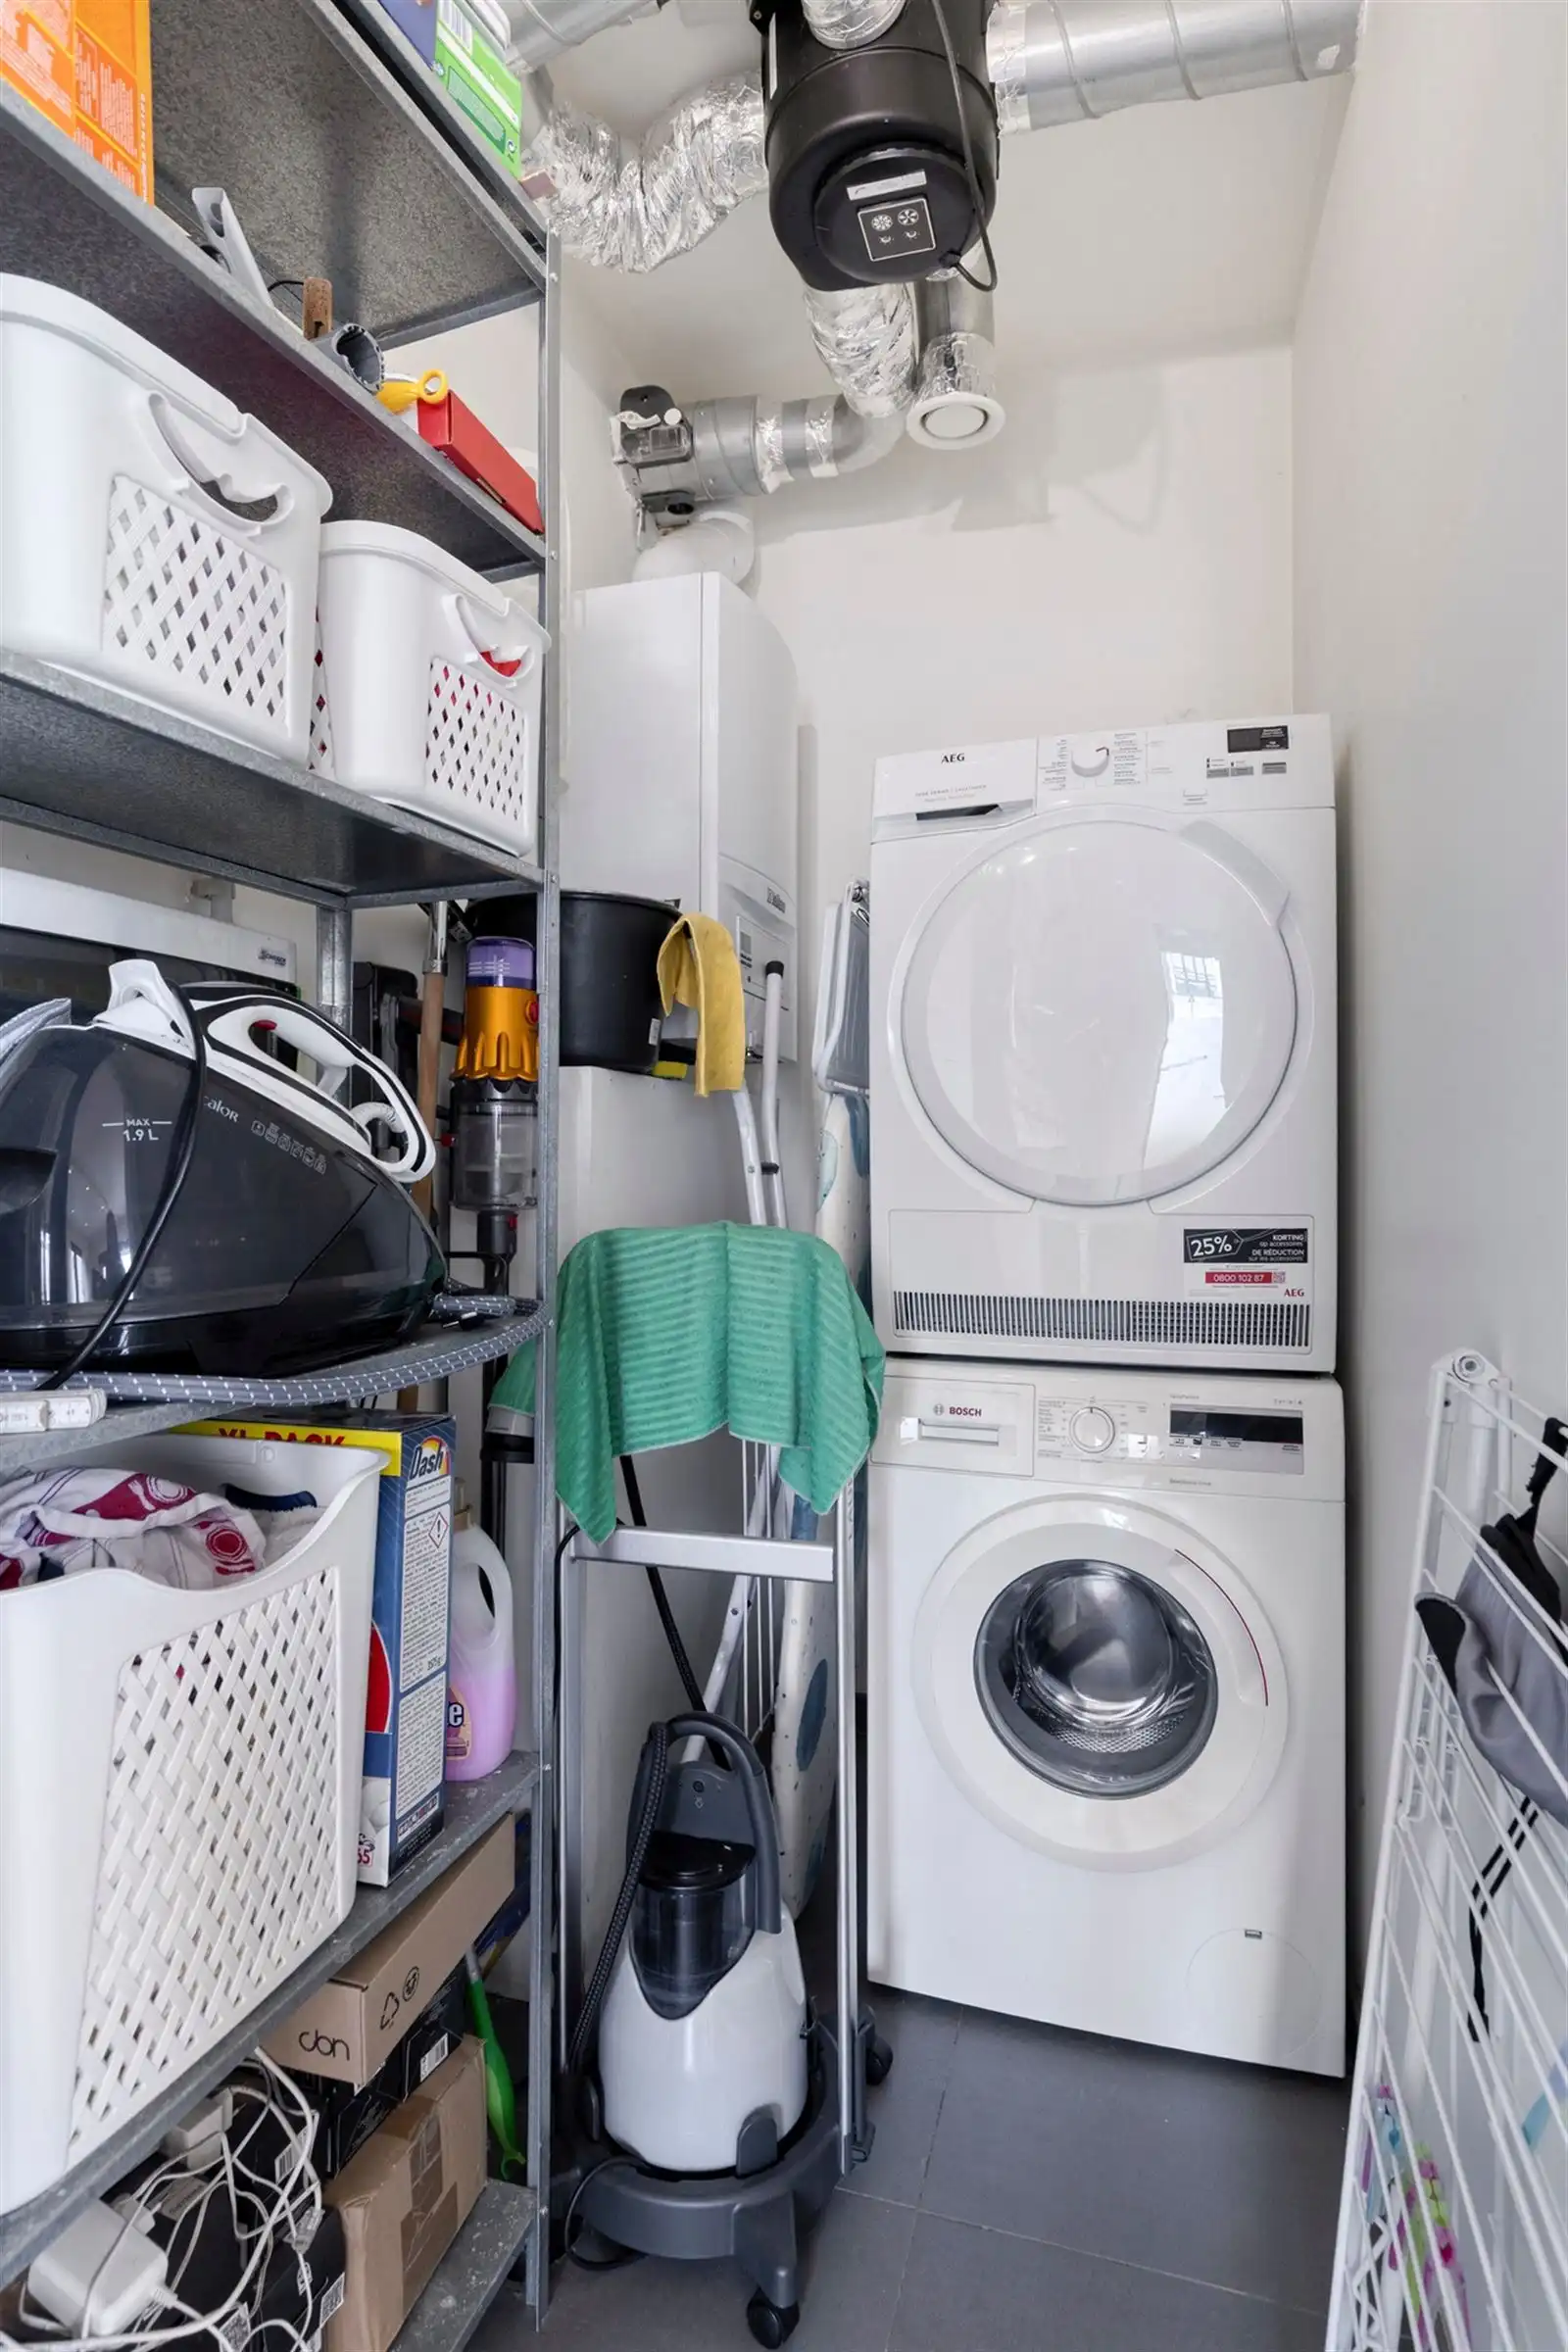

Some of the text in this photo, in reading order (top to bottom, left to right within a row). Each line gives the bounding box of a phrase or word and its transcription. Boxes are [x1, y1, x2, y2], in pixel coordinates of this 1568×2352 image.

[941, 753, 965, 764] AEG
[126, 1118, 150, 1127] MAX
[122, 1129, 159, 1142] 1.9 L
[1190, 1235, 1233, 1257] 25%
[1213, 1274, 1237, 1283] 0800
[1238, 1274, 1252, 1283] 102
[1284, 1289, 1304, 1298] AEG
[949, 1406, 982, 1417] BOSCH
[410, 1442, 444, 1480] Dash
